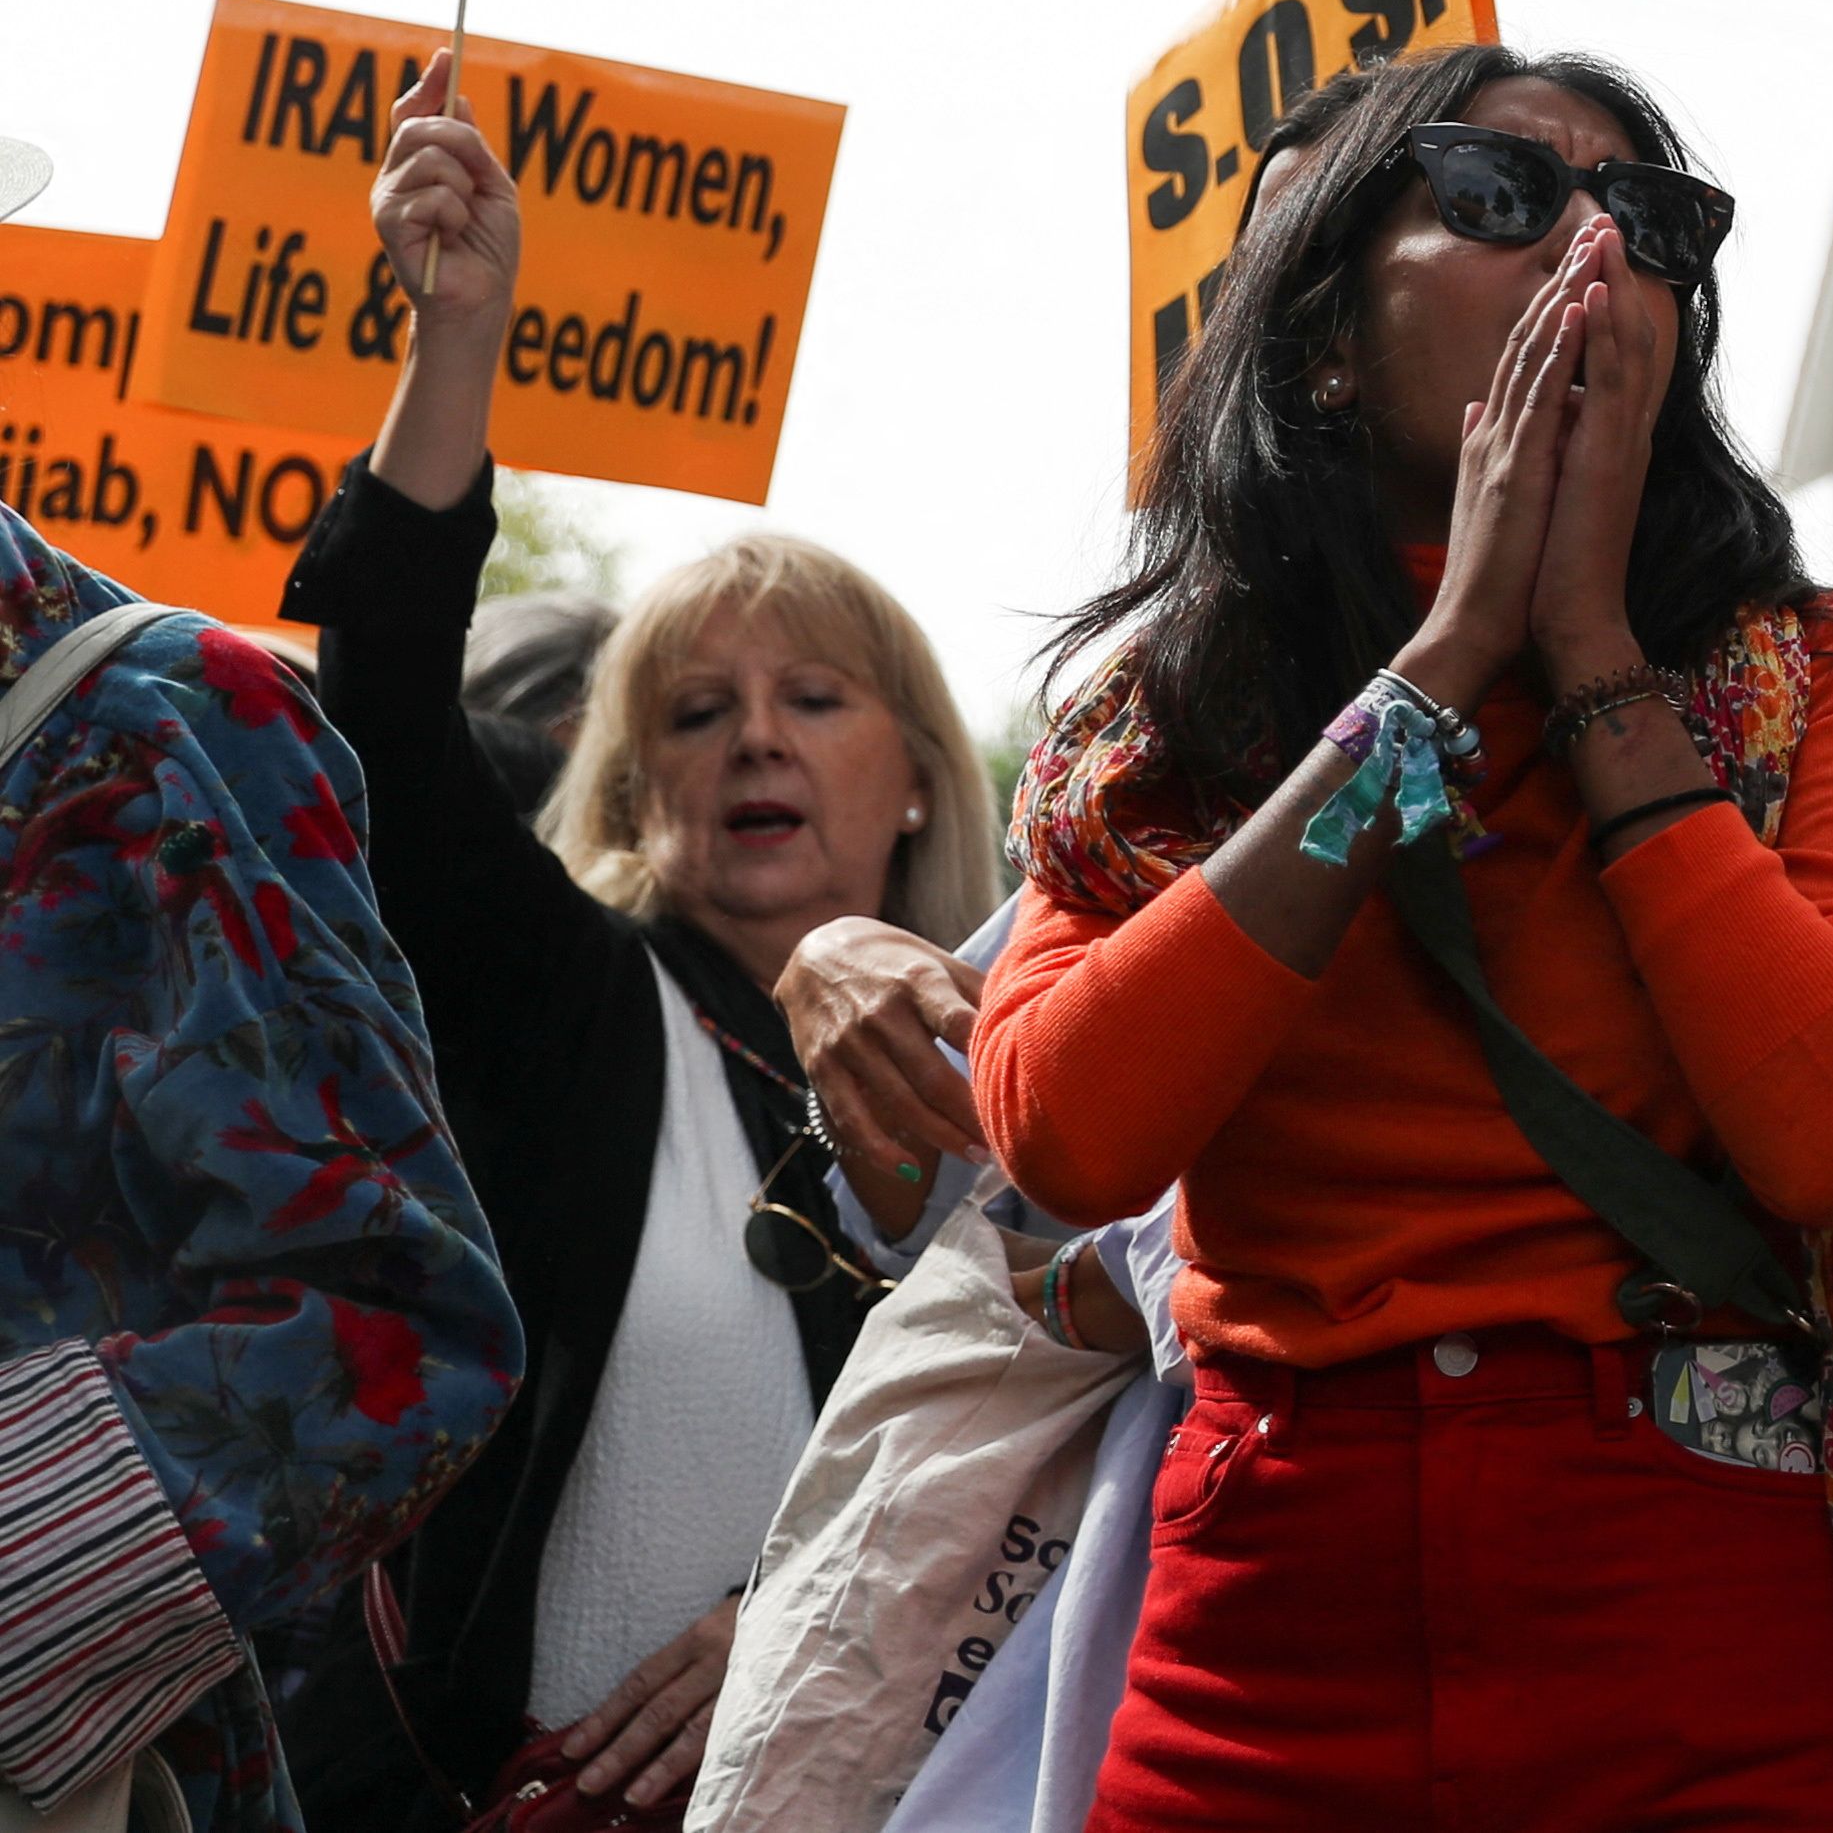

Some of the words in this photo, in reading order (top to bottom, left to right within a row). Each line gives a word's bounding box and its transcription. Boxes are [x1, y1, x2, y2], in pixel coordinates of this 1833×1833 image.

[507, 74, 786, 263] Women,
[188, 217, 329, 350] Life
[349, 250, 402, 361] &
[506, 291, 776, 426] eedom!
[184, 443, 328, 545] NO
